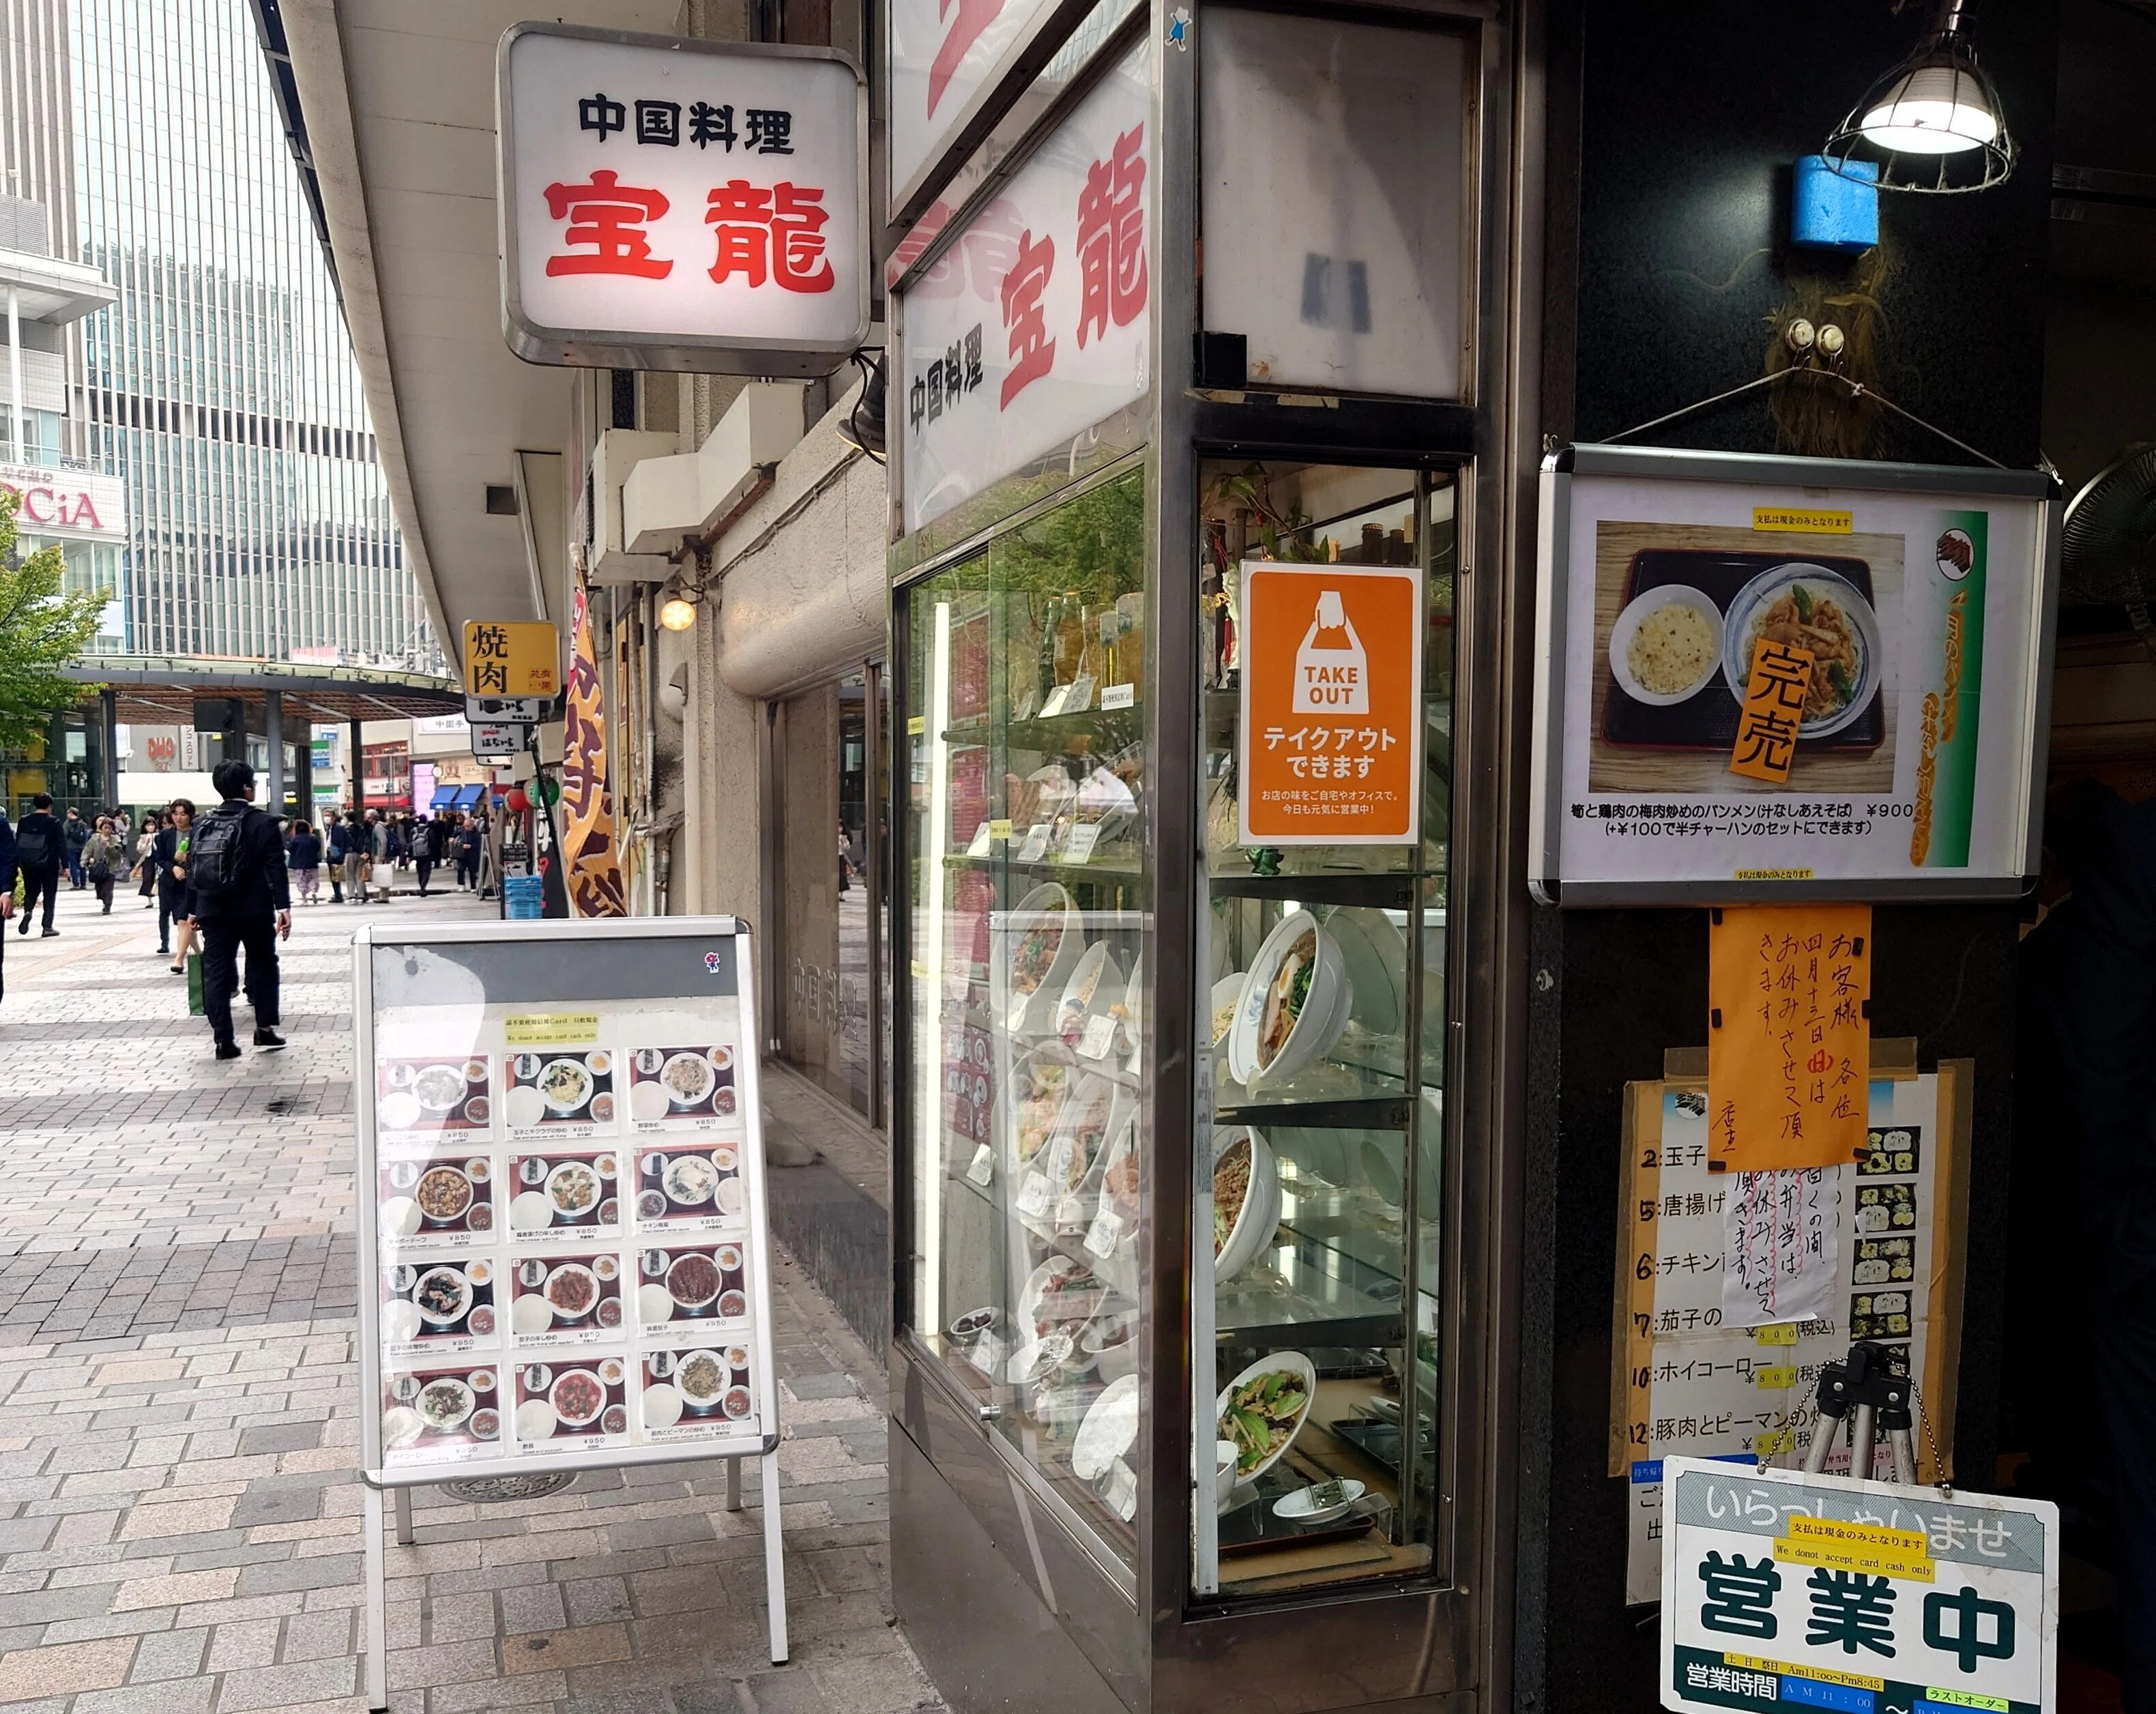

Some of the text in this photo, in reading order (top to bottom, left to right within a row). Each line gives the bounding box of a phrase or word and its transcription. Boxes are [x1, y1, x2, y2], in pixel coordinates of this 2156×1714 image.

[579, 93, 795, 156] 中国料理
[544, 170, 834, 293] 宝龍
[1000, 121, 1148, 412] 宝龍
[909, 323, 983, 436] 中国料理
[1756, 514, 1850, 527] 支払は現金のみとなります
[472, 625, 508, 693] 焼肉
[1305, 666, 1358, 684] TAKE
[1309, 687, 1354, 704] OUT
[1737, 645, 1810, 771] 完売
[1264, 726, 1397, 751] テイクアウト
[1287, 755, 1375, 779] できます
[1262, 790, 1398, 801] お店の味をご自宅やオフィスで。
[1283, 804, 1374, 815] 今日も元気に営業中!
[1867, 803, 1913, 817] ¥900
[1831, 1058, 1859, 1118] 各位
[1636, 1252, 1725, 1280] 6:チキン
[1793, 1522, 1923, 1550] 支払は現金のみとなります
[1777, 1545, 1932, 1575] We donot accept card cash only
[1698, 1550, 2015, 1673] 営業中
[1686, 1661, 1777, 1701] 営業時間
[1930, 1689, 2007, 1709] ラストオーダー
